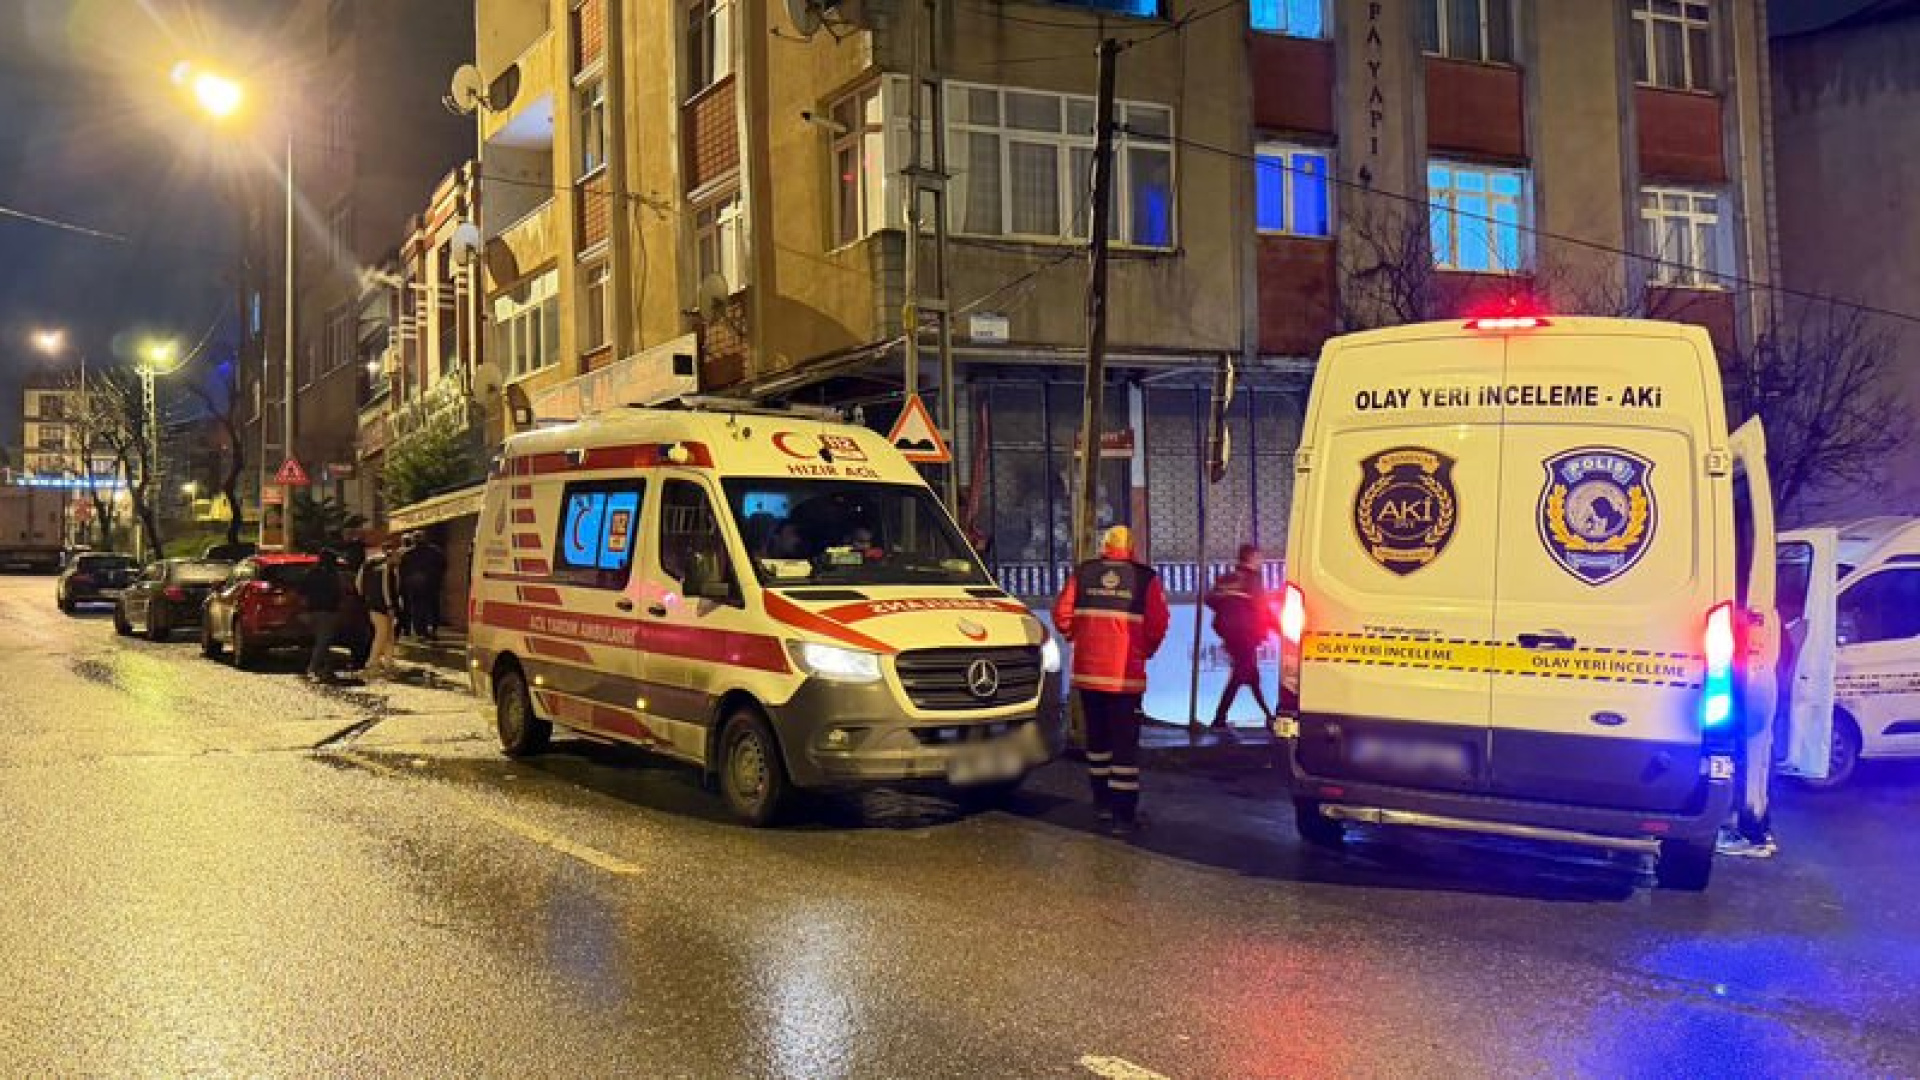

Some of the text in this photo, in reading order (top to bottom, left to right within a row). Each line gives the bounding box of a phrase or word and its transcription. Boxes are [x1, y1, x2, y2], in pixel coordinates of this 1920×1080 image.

[1355, 388, 1411, 411] OLAY
[1316, 642, 1349, 654] OLAY
[1532, 655, 1570, 668] OLAY
